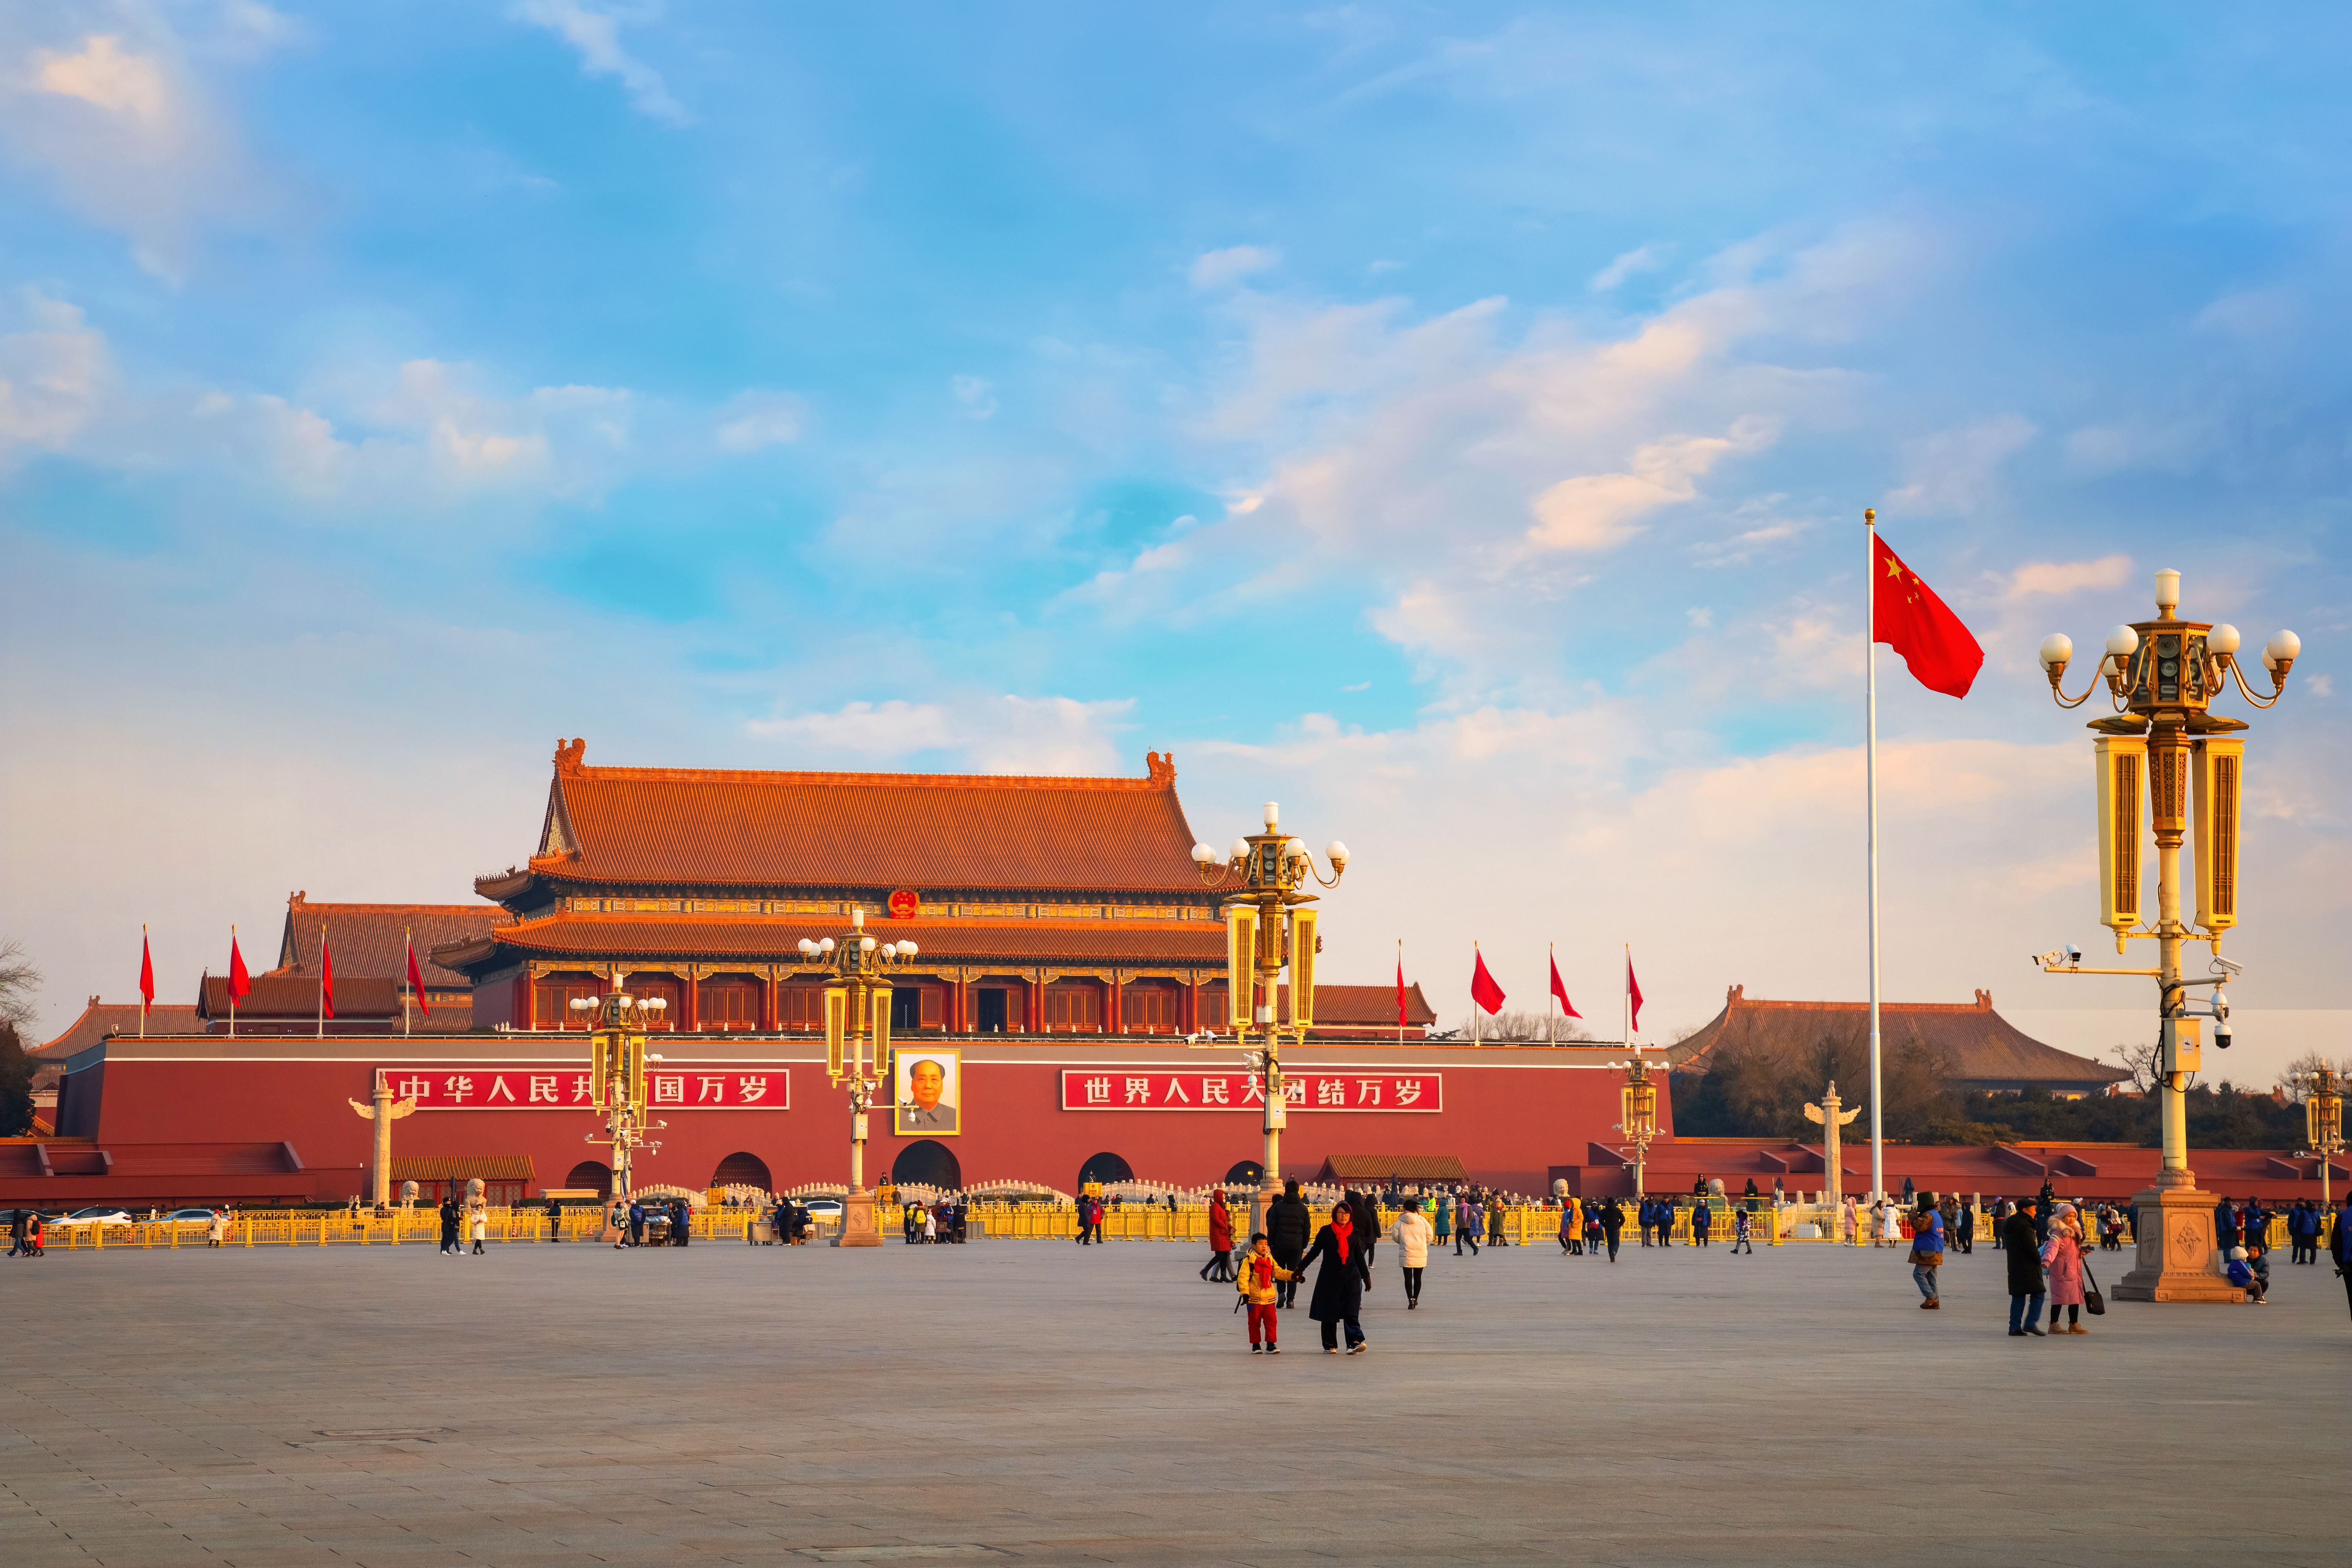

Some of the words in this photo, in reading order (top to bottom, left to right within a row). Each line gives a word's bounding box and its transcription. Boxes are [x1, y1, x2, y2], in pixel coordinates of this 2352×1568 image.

[400, 1076, 767, 1102] 中华人民共国万岁
